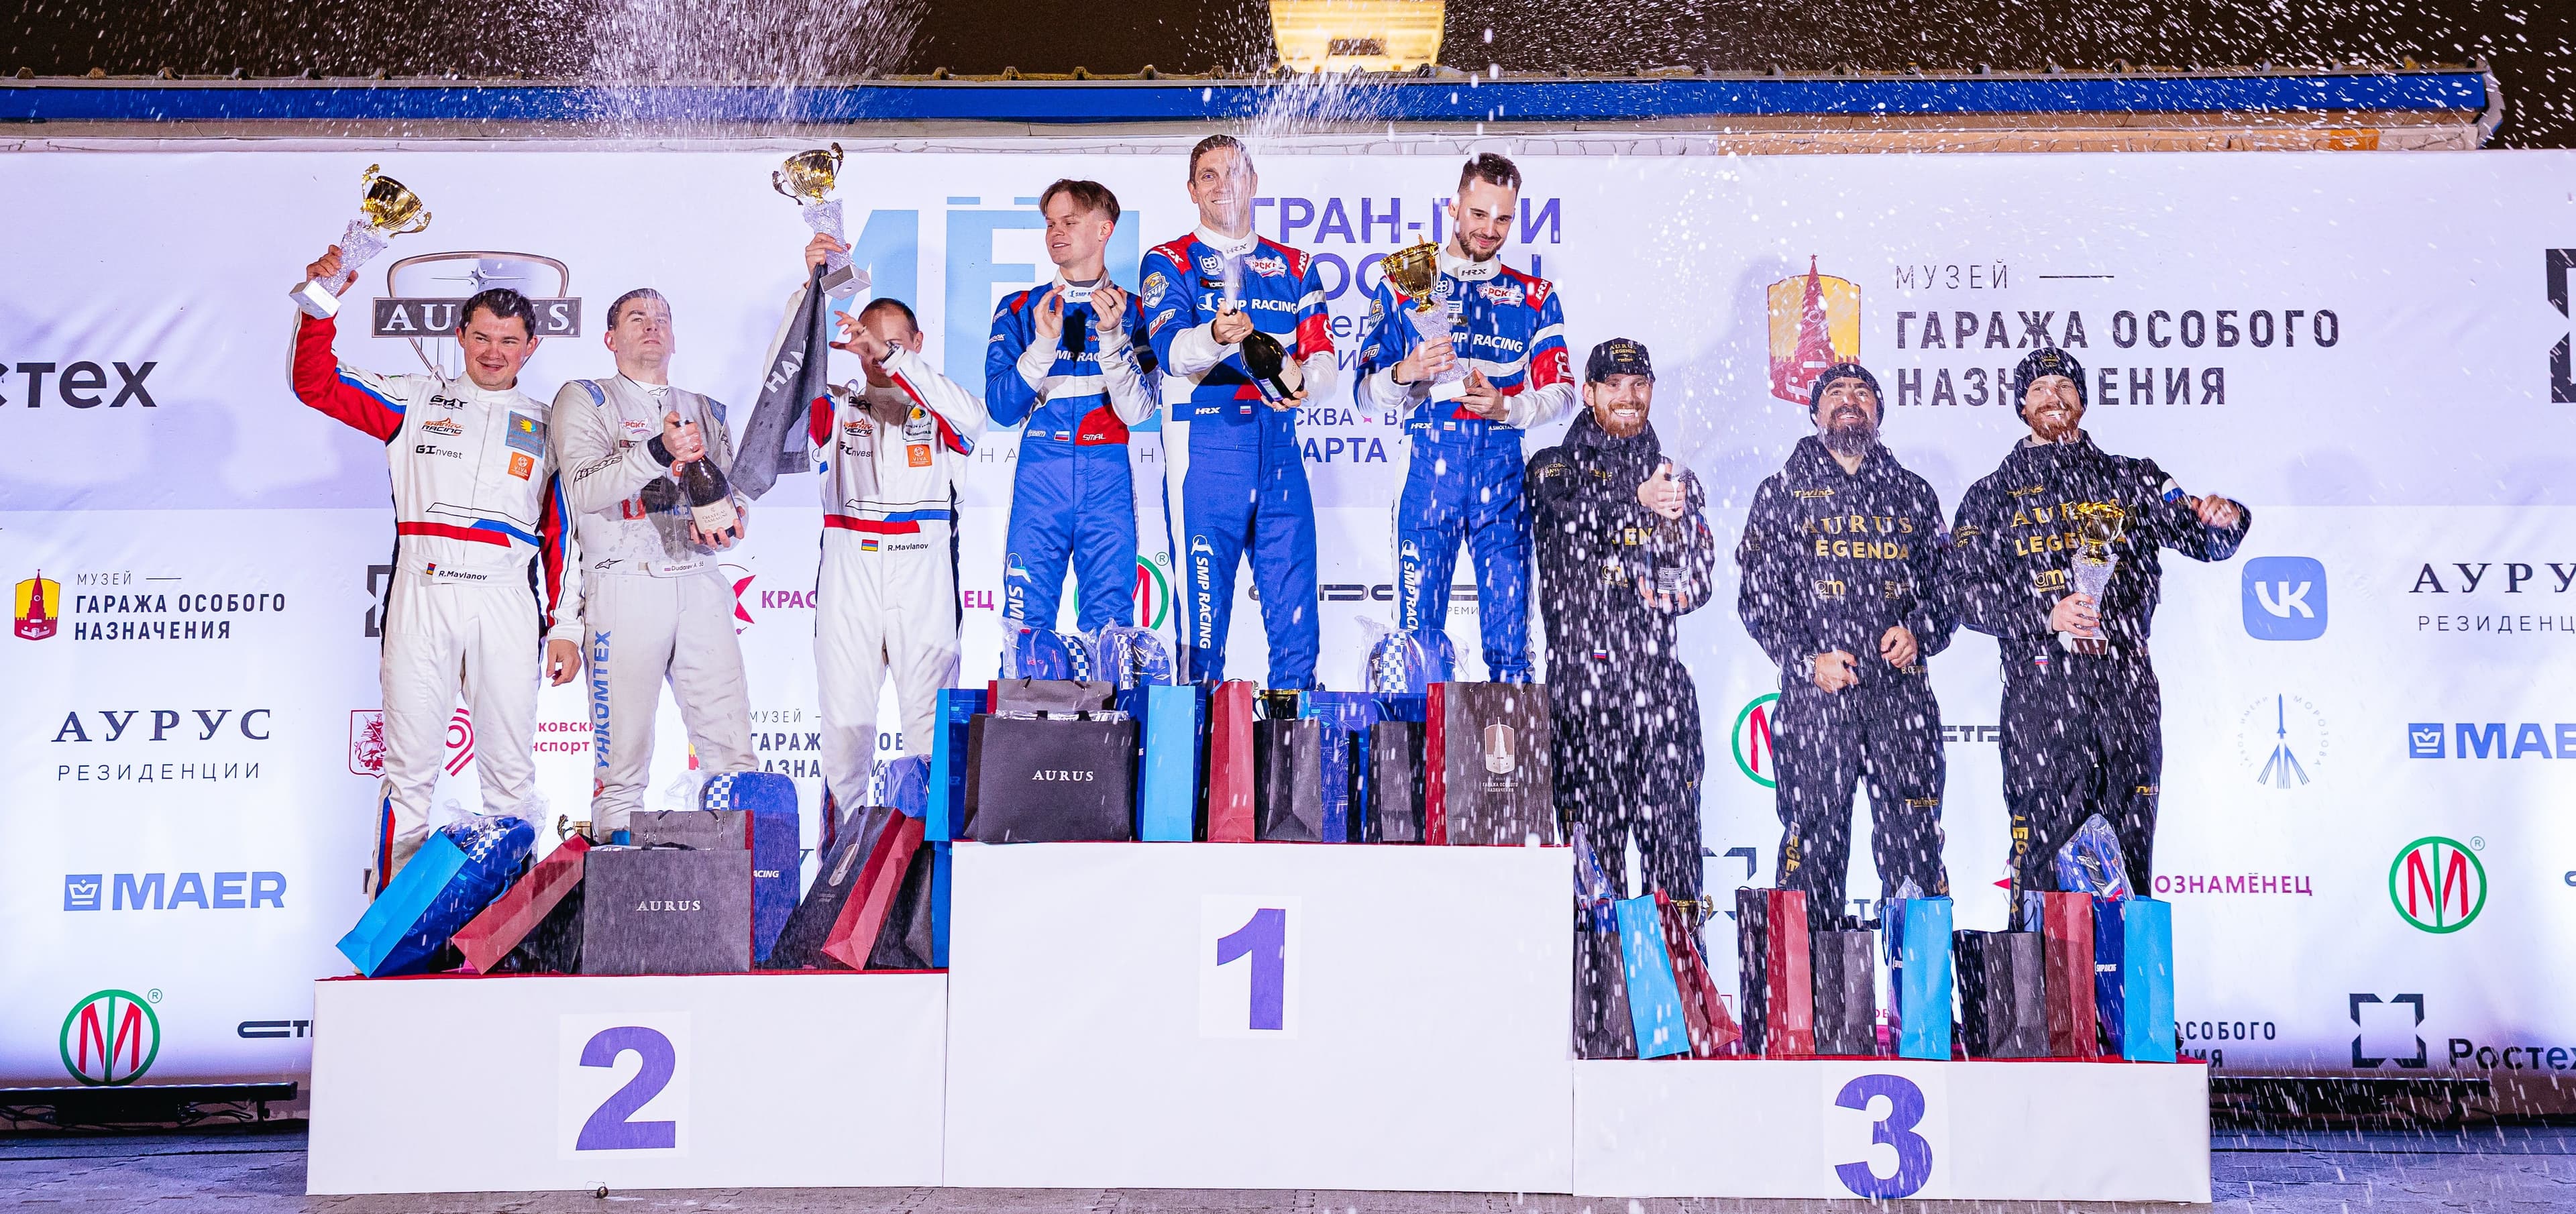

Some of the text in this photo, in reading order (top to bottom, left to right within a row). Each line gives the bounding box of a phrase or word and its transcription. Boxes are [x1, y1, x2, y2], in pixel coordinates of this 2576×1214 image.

[1461, 268, 1487, 276] HRX
[1896, 258, 2010, 289] МУЗЕЙ
[1252, 300, 1297, 314] RACING
[382, 304, 570, 332] AUS
[1898, 309, 2339, 349] ГАРАЖА ОСОБОГО
[1473, 335, 1523, 352] RACING
[0, 360, 158, 409] тех
[1898, 368, 2225, 406] НАЗНЕНИЯ
[1195, 407, 1221, 415] HRX
[421, 425, 463, 435] RACING
[1303, 438, 1387, 463] АРТА
[888, 543, 929, 551] R.Mavlanov
[1816, 540, 1909, 559] EGENDA
[77, 571, 131, 586] МУЗЕЙ
[439, 570, 488, 581] R.Mavlanov
[2409, 563, 2576, 593] АУРУ
[75, 594, 285, 613] ГАРАЖА ОСОБОГО
[1196, 557, 1212, 649] SMP RACING
[1406, 596, 1418, 630] RACI
[74, 620, 231, 641] НАЗНАЧЕНИЯ
[2419, 615, 2576, 634] РЕЗИДЕНЦ
[51, 709, 271, 742] АУРУС
[751, 733, 821, 751] ГАРАЖ
[2456, 722, 2576, 759] MAE
[59, 763, 260, 782] РЕЗИДЕНЦИИ
[1032, 769, 1094, 781] AURUS
[753, 870, 780, 879] ACING
[2155, 873, 2313, 897] ОЗНАМЁНЕЦ
[112, 871, 286, 911] MAER
[636, 900, 701, 912] AURUS
[1216, 907, 1286, 1030] 1
[576, 1026, 676, 1151] 2
[1835, 1074, 1933, 1200] 3
